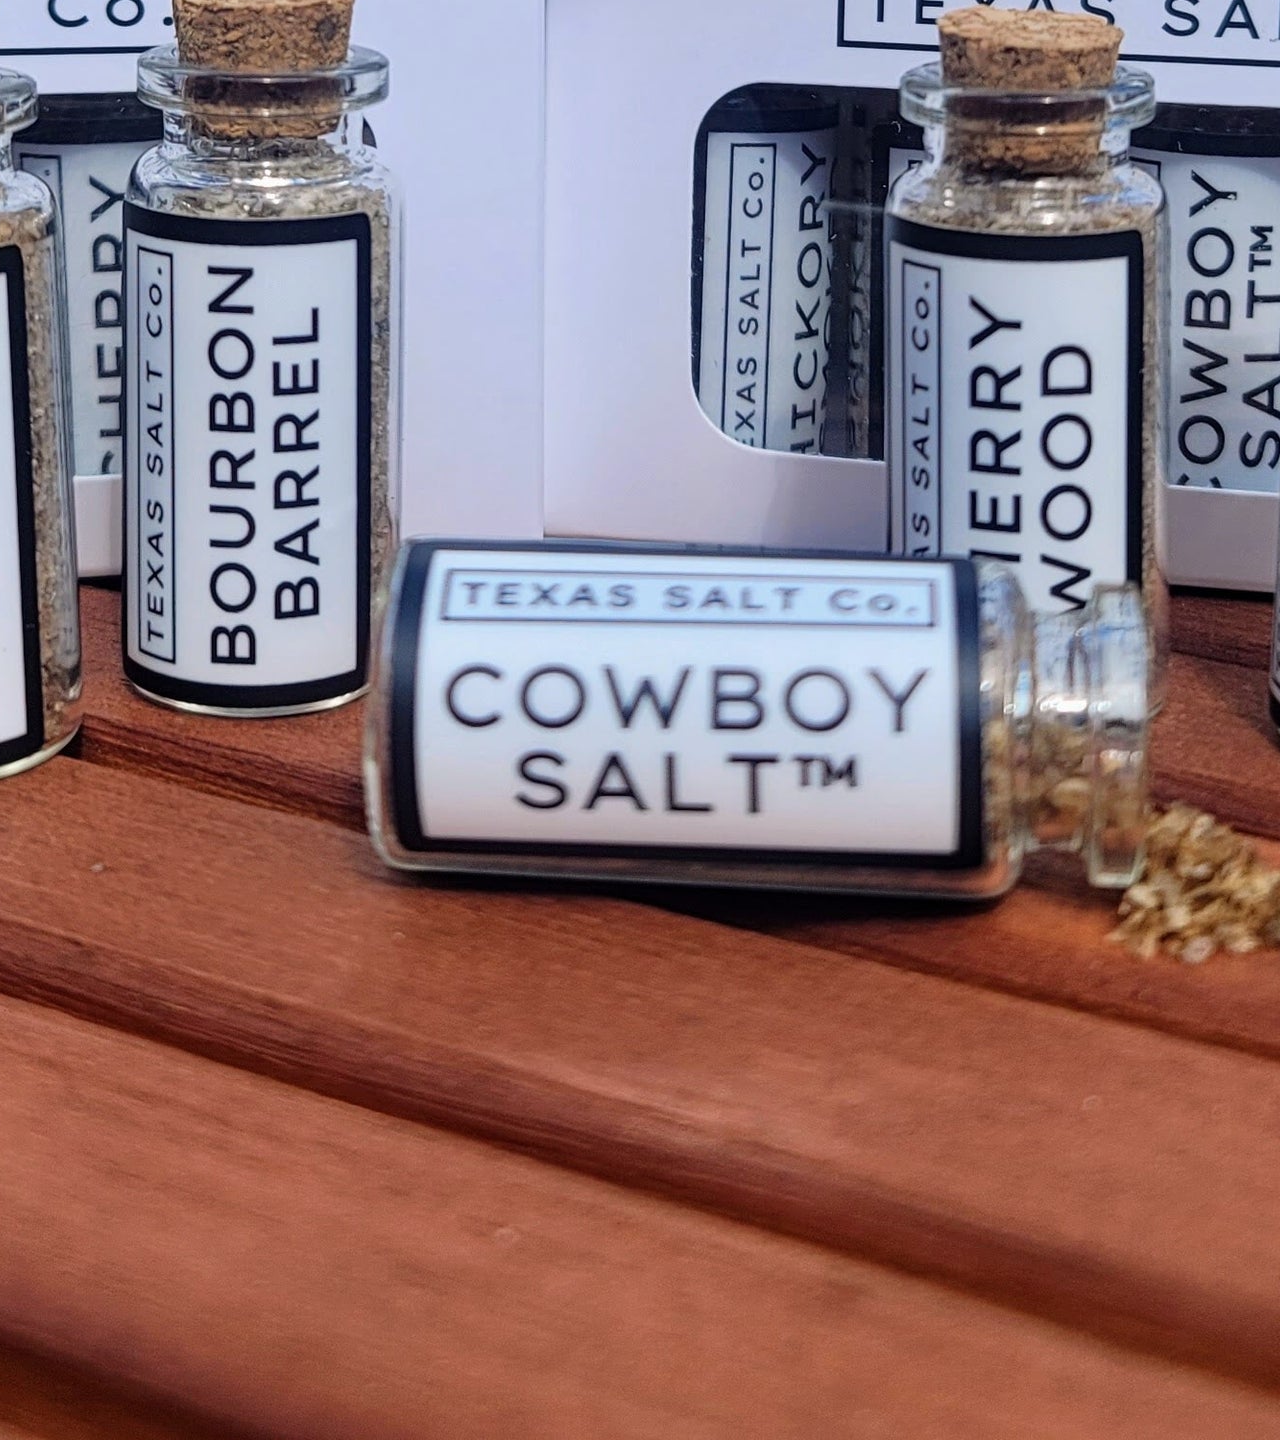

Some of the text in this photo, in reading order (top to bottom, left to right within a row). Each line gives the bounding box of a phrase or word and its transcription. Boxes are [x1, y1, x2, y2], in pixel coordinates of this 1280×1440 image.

[742, 157, 765, 219] Co.
[738, 238, 763, 335] SALT
[912, 280, 931, 352] Co.
[1177, 168, 1238, 488] OWBOY
[145, 265, 165, 643] TEXAS SALT Co.
[207, 265, 257, 666] BOURBON
[272, 307, 320, 620] BARREL
[912, 372, 931, 491] SALT
[1040, 345, 1092, 615] WOOD
[461, 581, 635, 608] TEXAS
[662, 584, 803, 613] SALT
[446, 664, 931, 734] COWBOY
